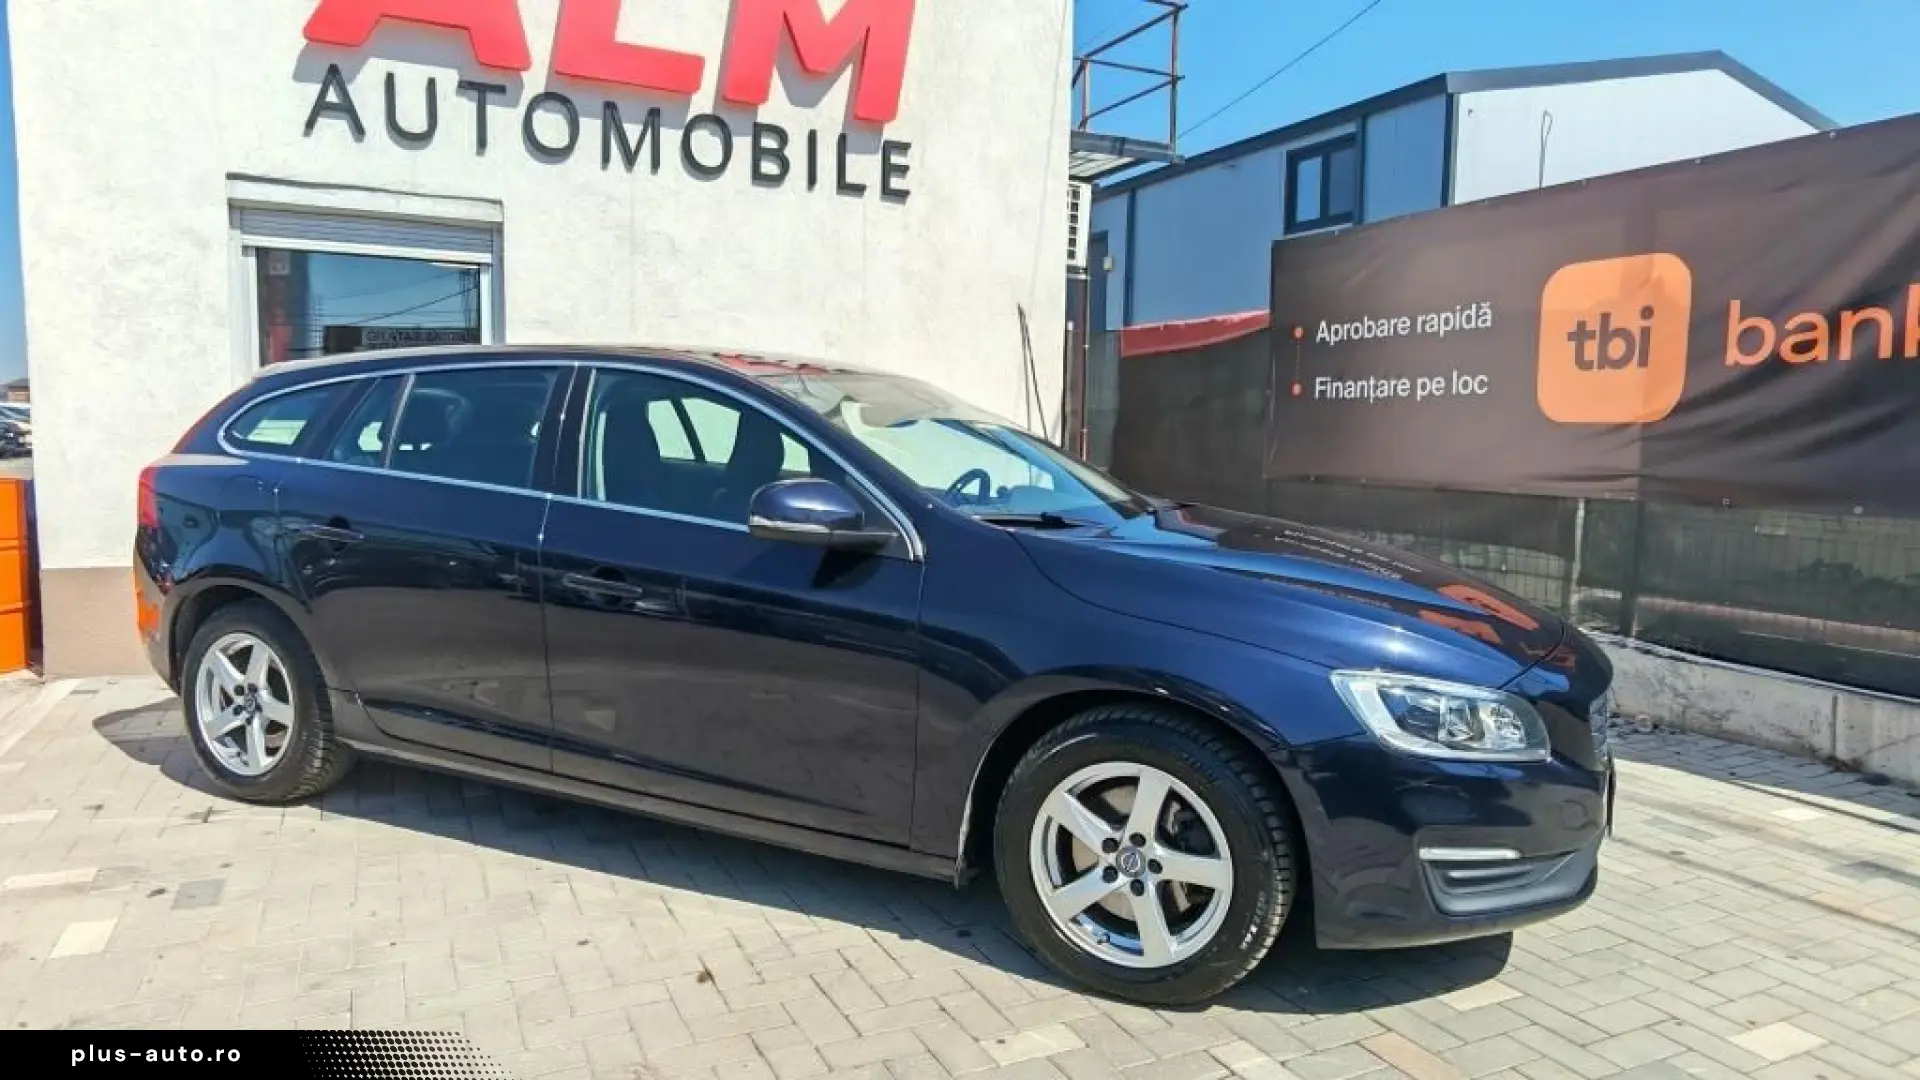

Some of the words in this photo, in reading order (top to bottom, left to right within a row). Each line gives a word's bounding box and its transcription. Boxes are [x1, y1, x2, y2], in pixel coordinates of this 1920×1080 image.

[304, 64, 911, 199] AUTOMOBILE
[1315, 316, 1411, 346] Aprobare
[1417, 301, 1493, 337] rapidă
[1567, 305, 1655, 371] tbi
[1314, 375, 1411, 404] Finanțare
[1417, 375, 1445, 402] pe
[1452, 368, 1490, 396] loc
